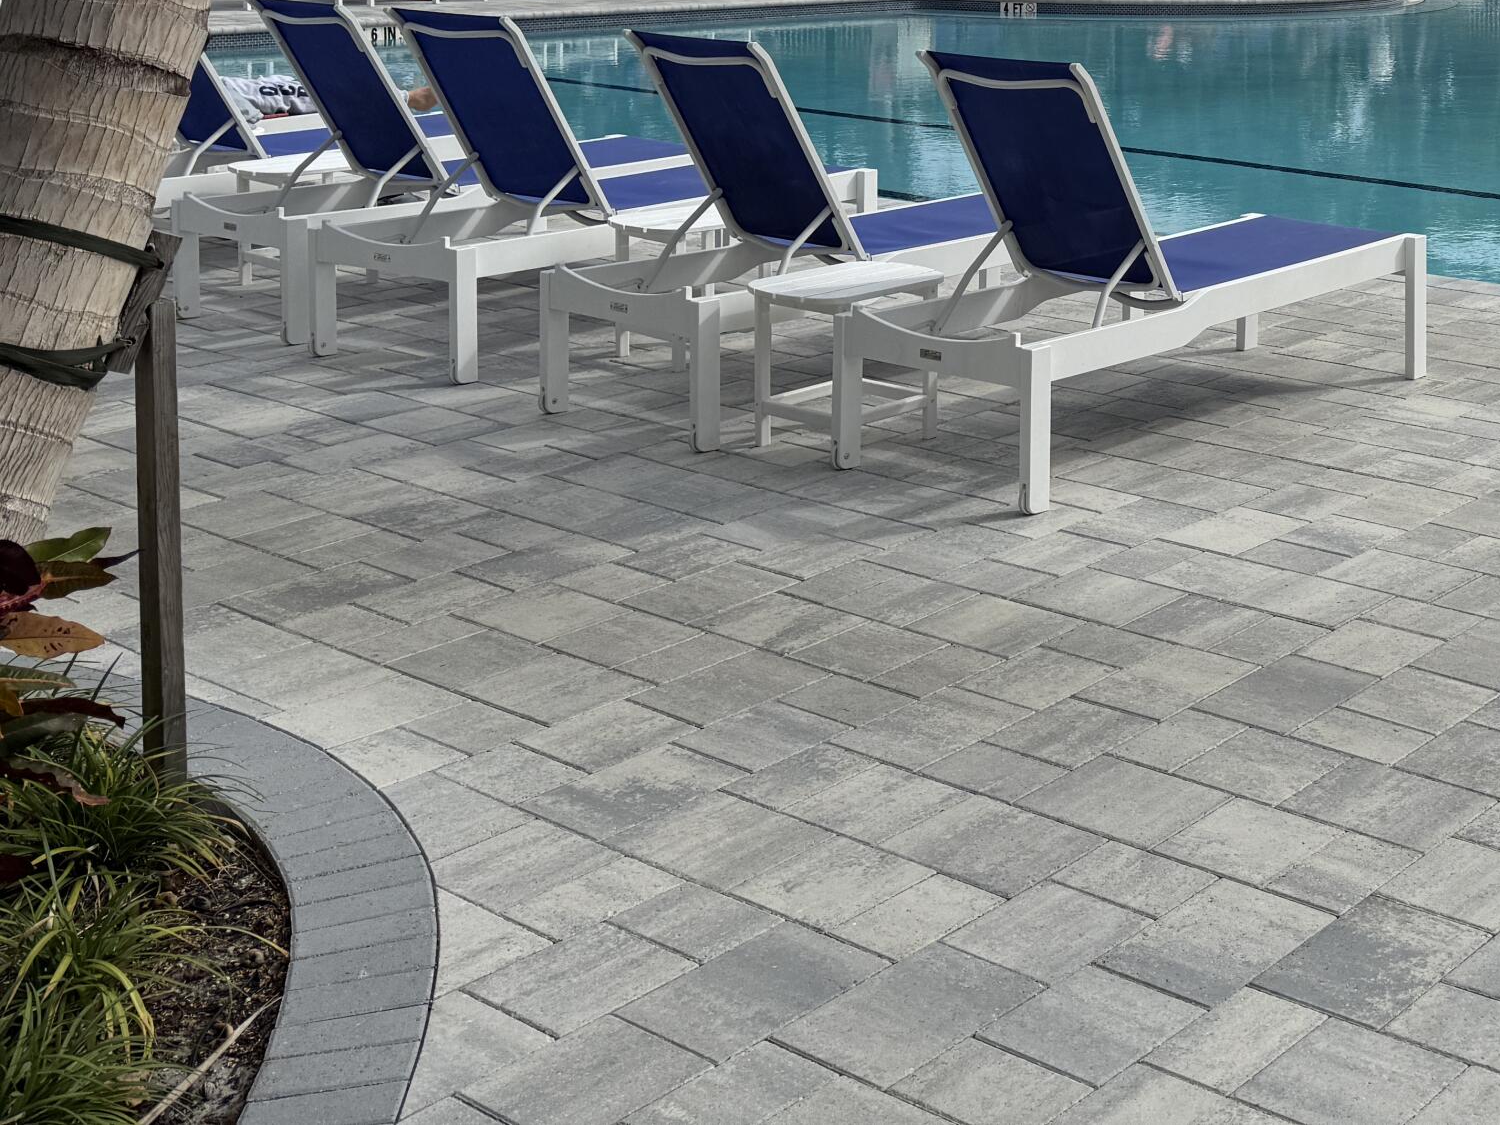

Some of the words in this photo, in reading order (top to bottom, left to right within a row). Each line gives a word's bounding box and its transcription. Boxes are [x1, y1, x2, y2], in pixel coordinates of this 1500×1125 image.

[1012, 2, 1024, 14] FT
[371, 27, 378, 42] 6
[383, 26, 397, 43] IN
